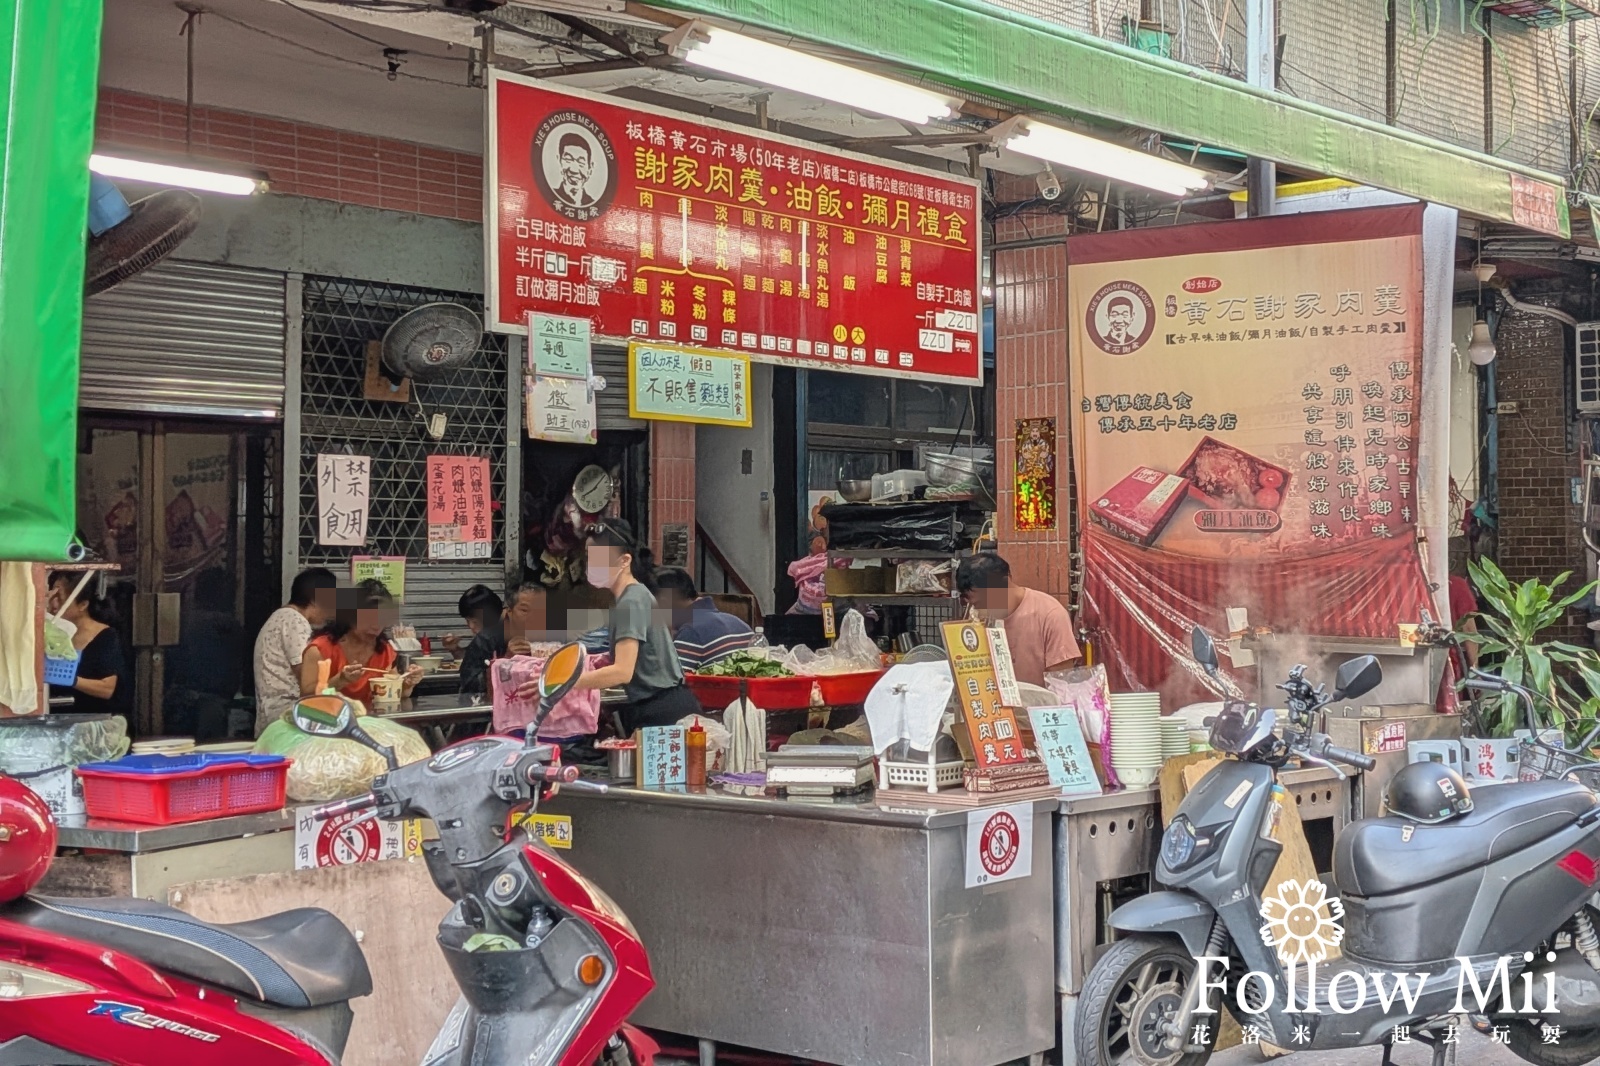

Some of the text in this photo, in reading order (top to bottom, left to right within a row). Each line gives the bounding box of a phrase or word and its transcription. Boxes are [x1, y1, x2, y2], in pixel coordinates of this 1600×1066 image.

[534, 112, 615, 161] XIE'S HOUSE MEAT SOUP
[515, 217, 587, 248] 古早味油飯
[816, 223, 829, 308] 淡水魚丸湯
[875, 234, 888, 284] 油豆腐
[900, 239, 912, 287] 燙青菜
[515, 275, 601, 307] 訂做彌月油飯
[660, 280, 675, 316] 米粉
[692, 285, 707, 320] 冬粉
[1100, 283, 1122, 297] HOUSE
[1122, 283, 1139, 293] MEAT
[1138, 290, 1152, 308] SOUP
[1184, 279, 1219, 291] 創始店
[722, 289, 736, 324] 粿條
[947, 311, 974, 331] 220
[1180, 284, 1408, 327] 黃石謝家肉羹
[543, 320, 577, 336] 公休日
[633, 320, 648, 334] 60
[661, 322, 675, 336] 60
[693, 326, 707, 340] 60
[723, 331, 736, 344] 60
[762, 336, 775, 349] 40
[779, 338, 792, 351] 60
[816, 342, 828, 355] 60
[876, 350, 889, 362] 20
[921, 331, 946, 350] 220
[542, 339, 567, 358] 每週
[690, 356, 712, 372] 假日
[546, 412, 568, 429] 助手
[1098, 413, 1238, 434] 傳承五十年老店
[1329, 363, 1362, 523] 呼朋引伴來作伙
[1361, 381, 1393, 540] 喚起兒時家鄉味
[1302, 383, 1333, 539] 共享這般好滋味
[321, 459, 349, 541] 外食
[345, 460, 368, 537] 禁用
[432, 463, 446, 513] 蛋花湯
[966, 678, 1001, 765] 自製肉羹
[1043, 712, 1060, 725] 公告
[1048, 745, 1076, 760] 不提供
